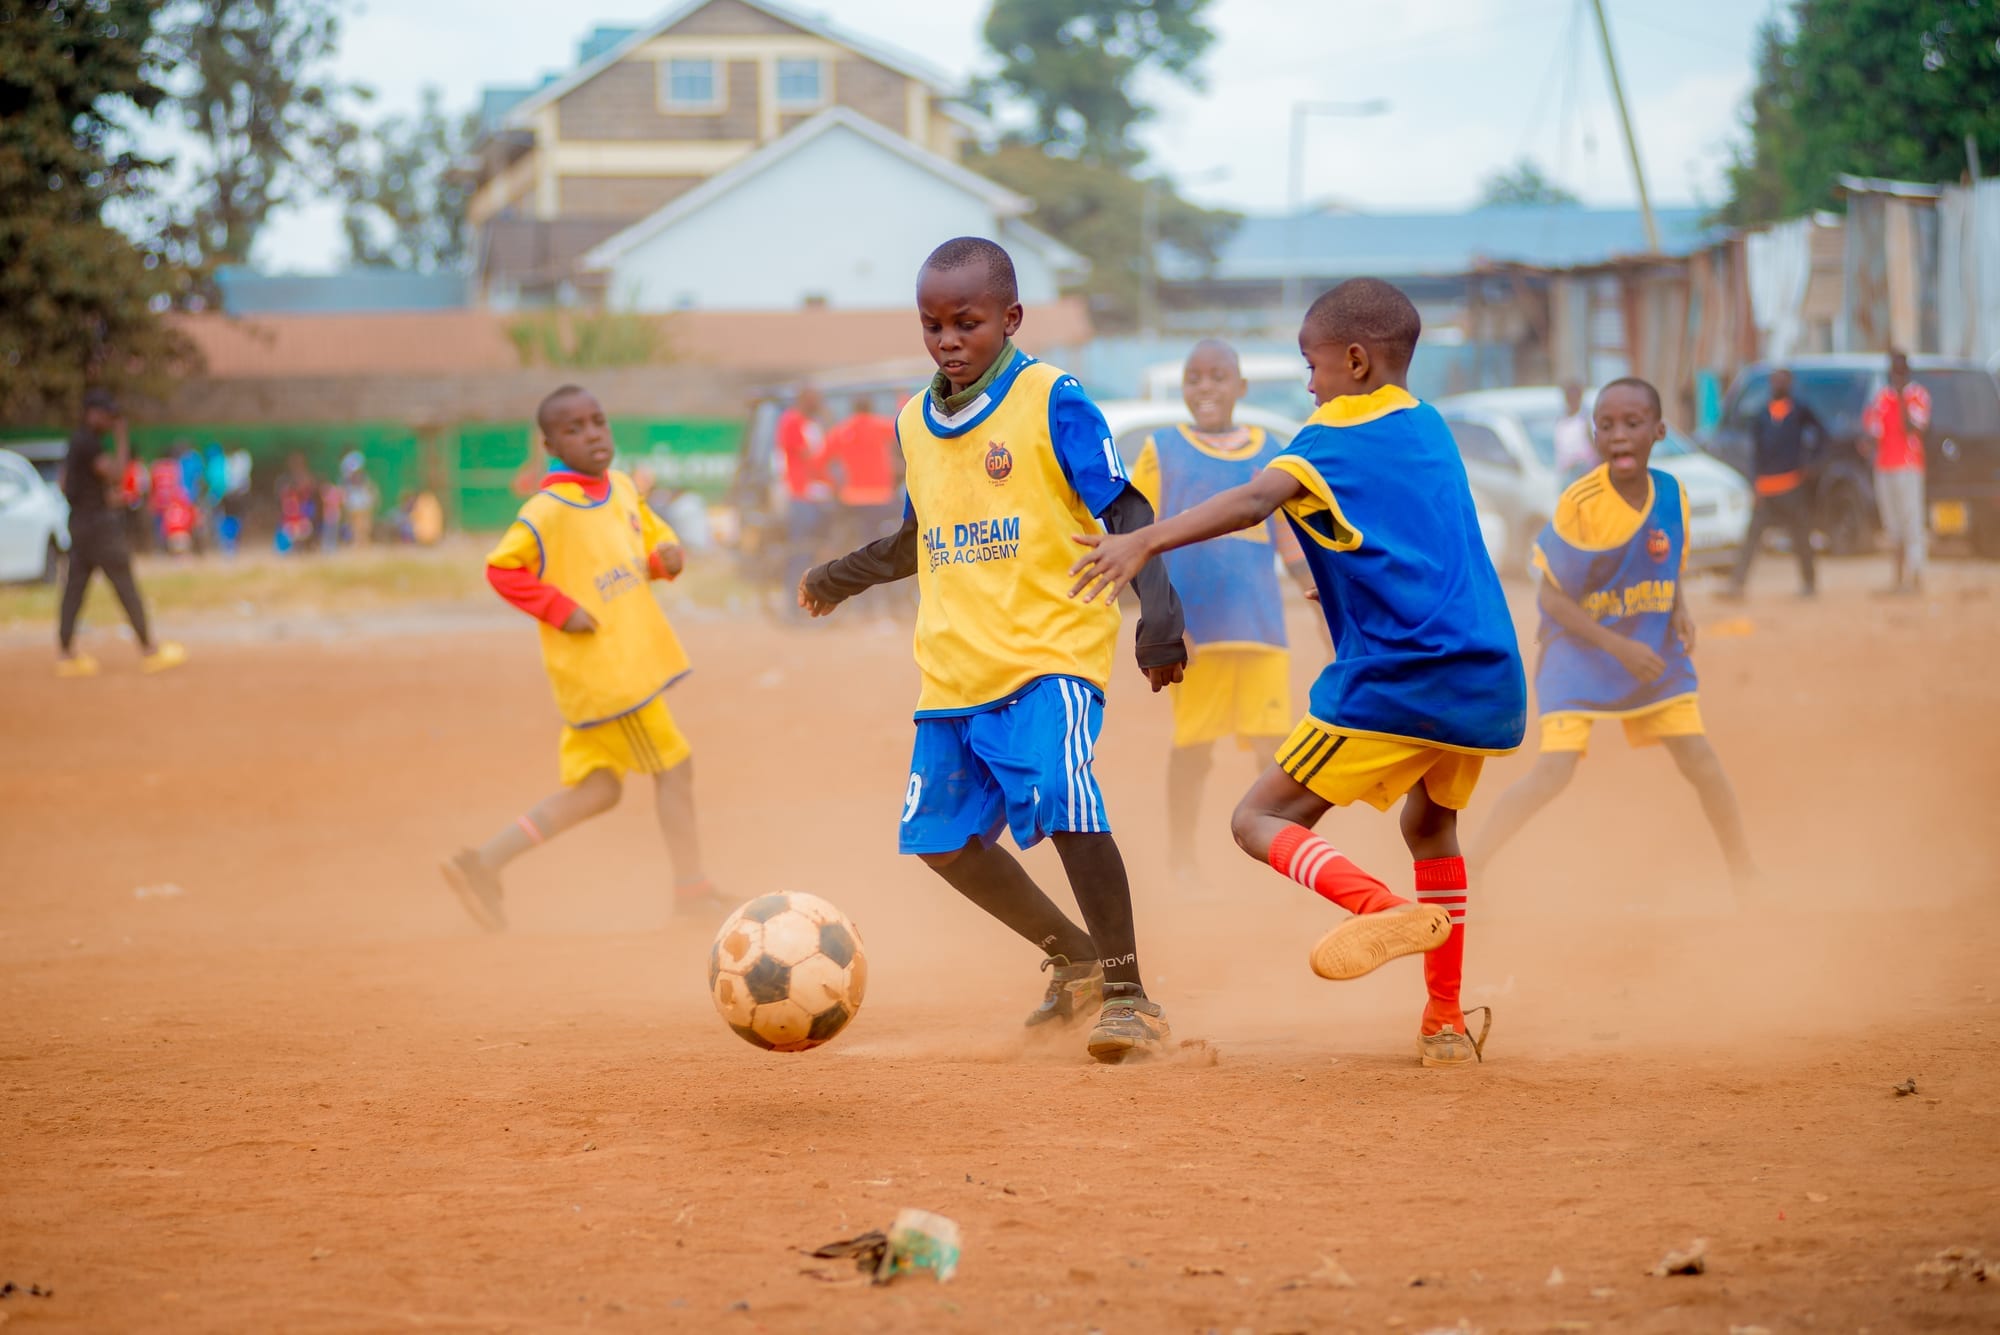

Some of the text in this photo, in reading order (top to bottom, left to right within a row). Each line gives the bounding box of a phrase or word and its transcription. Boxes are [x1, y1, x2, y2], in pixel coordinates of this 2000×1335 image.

[987, 454, 1010, 471] GDA
[954, 516, 1020, 547] DREAM
[953, 543, 1019, 564] ACADEMY
[902, 772, 922, 822] 9
